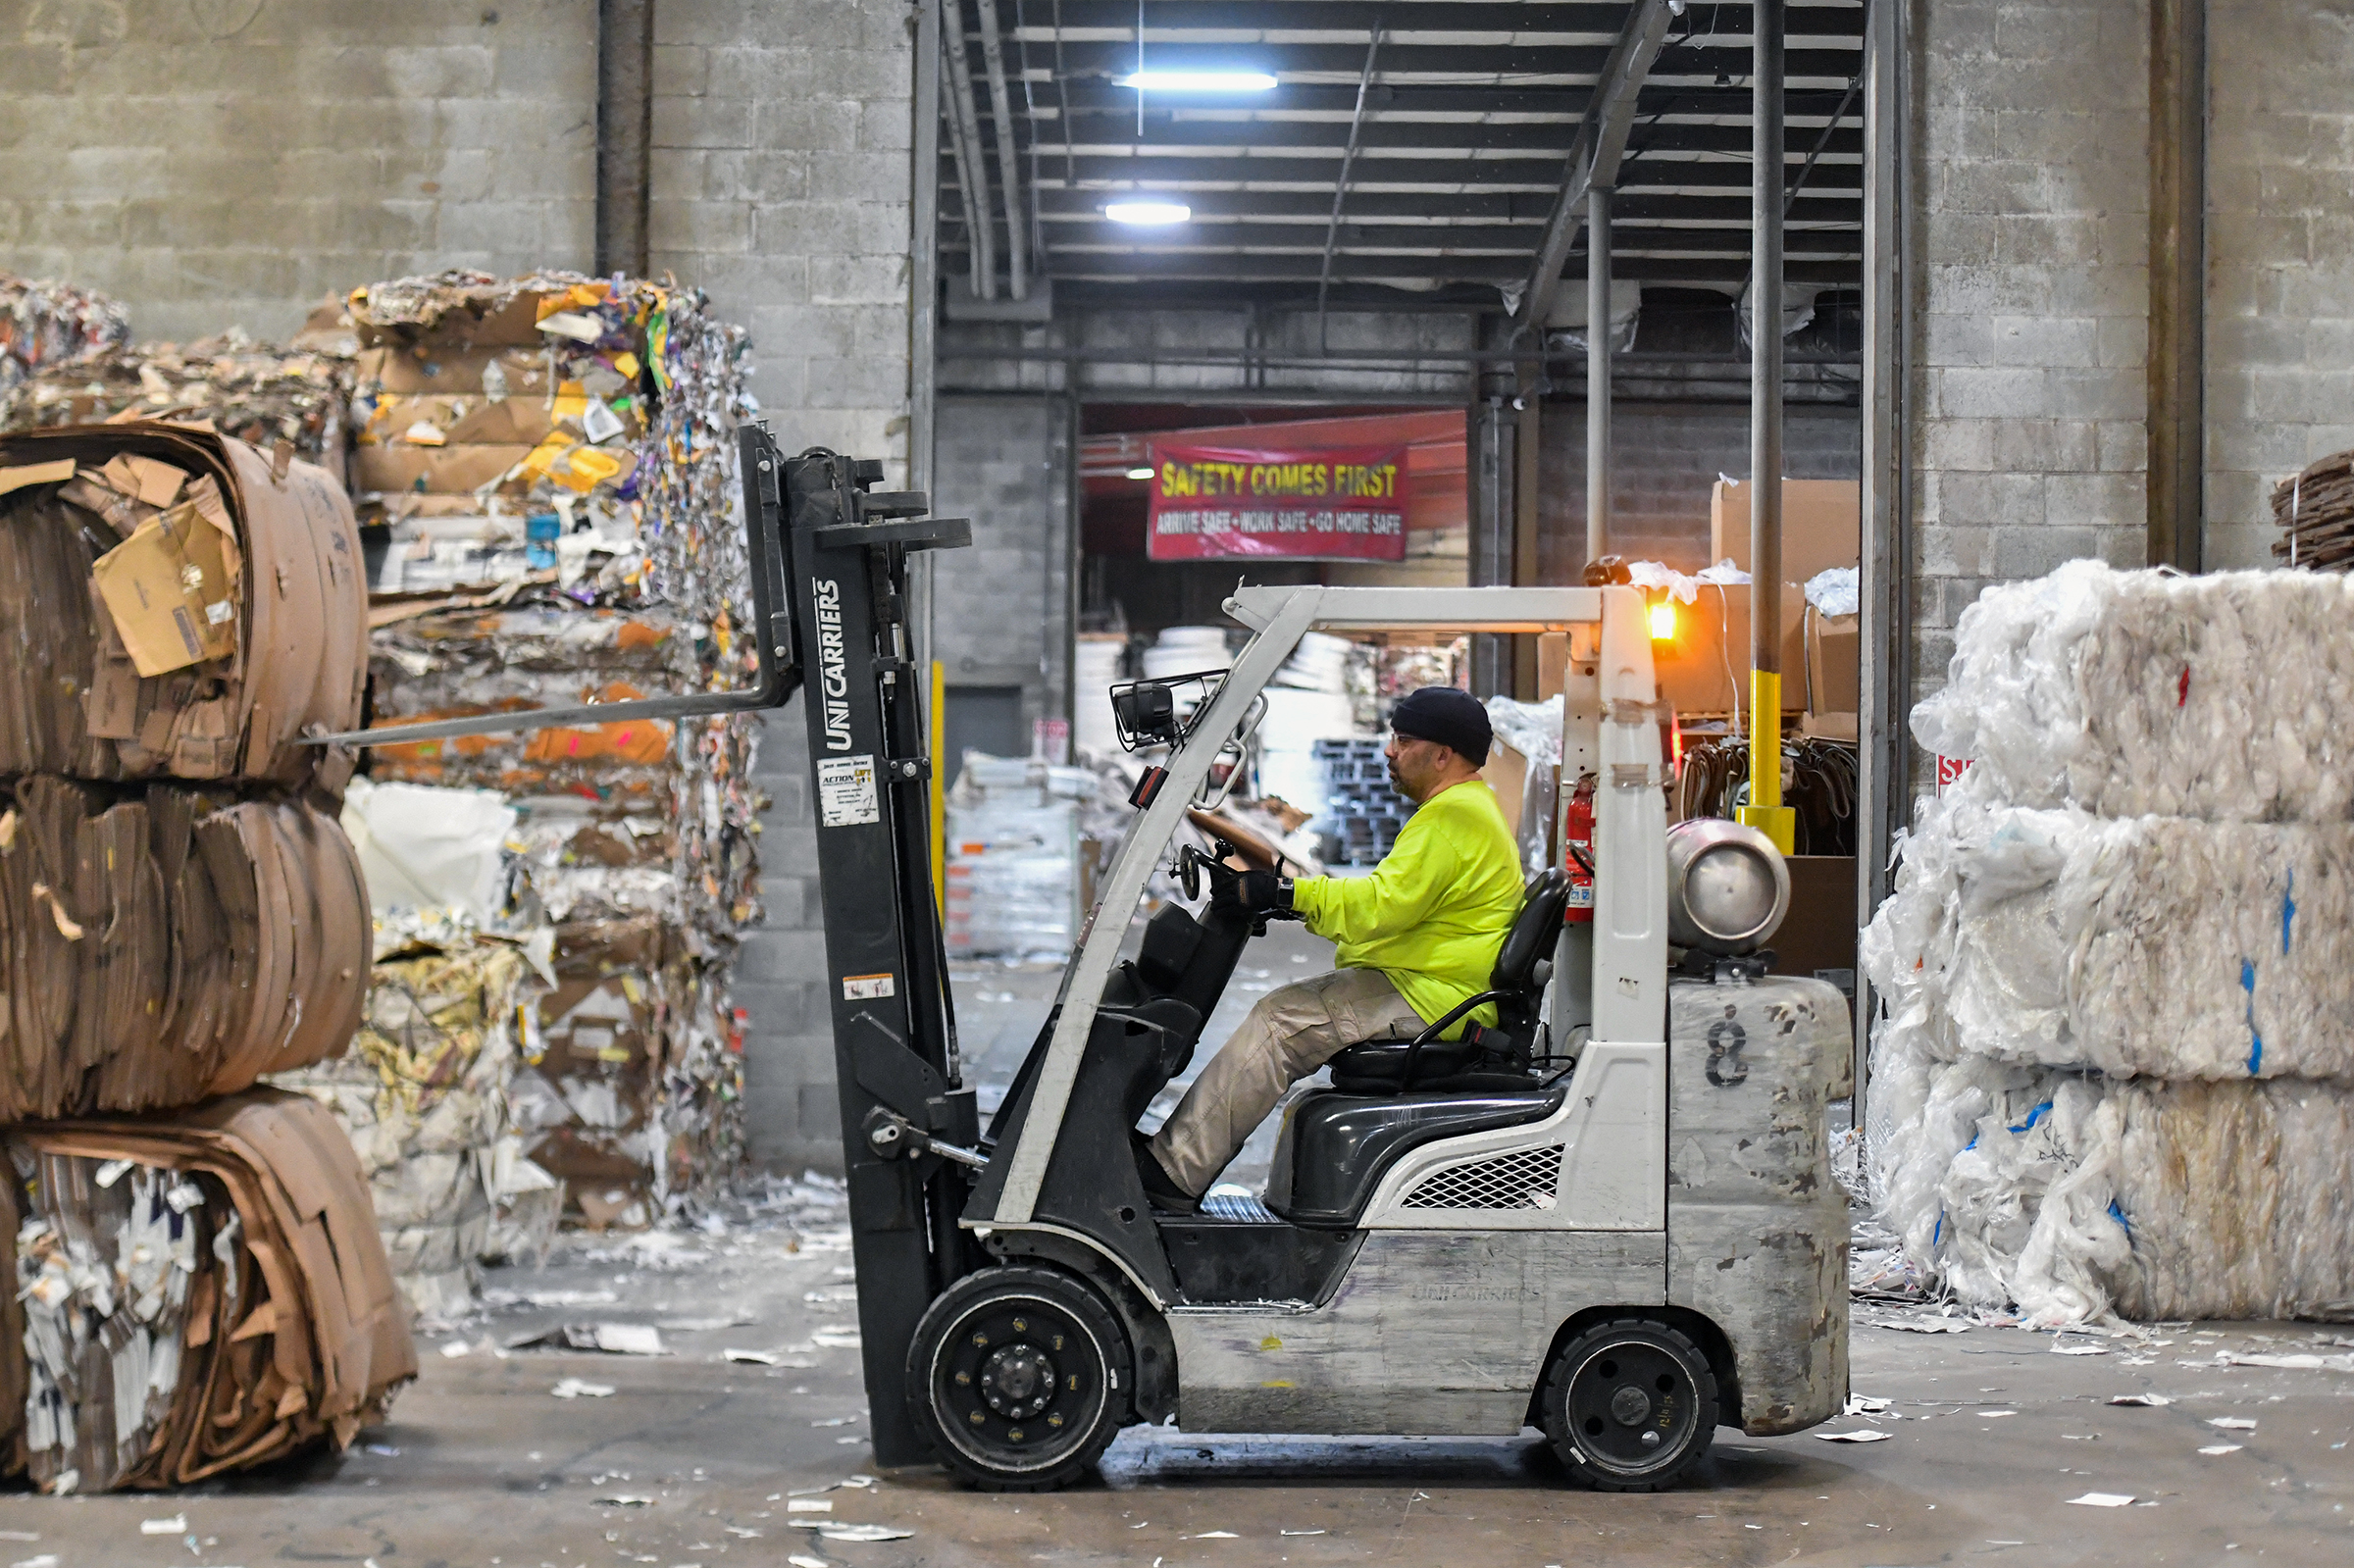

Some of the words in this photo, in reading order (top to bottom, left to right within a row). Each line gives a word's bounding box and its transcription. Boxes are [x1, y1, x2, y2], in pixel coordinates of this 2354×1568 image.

[1161, 462, 1246, 497] SAFETY
[1251, 464, 1328, 496] COMES
[1334, 464, 1397, 497] FIRST
[1156, 511, 1199, 534] ARRIVE
[1202, 511, 1232, 534] SAFE
[1240, 511, 1274, 532] WORK
[1277, 511, 1307, 532] SAFE
[1315, 512, 1334, 532] GO
[1336, 512, 1369, 532] HOME
[1372, 513, 1402, 534] SAFE
[812, 577, 852, 751] UNICARRIERS
[823, 775, 853, 784] ACTION
[1705, 1021, 1748, 1087] 8
